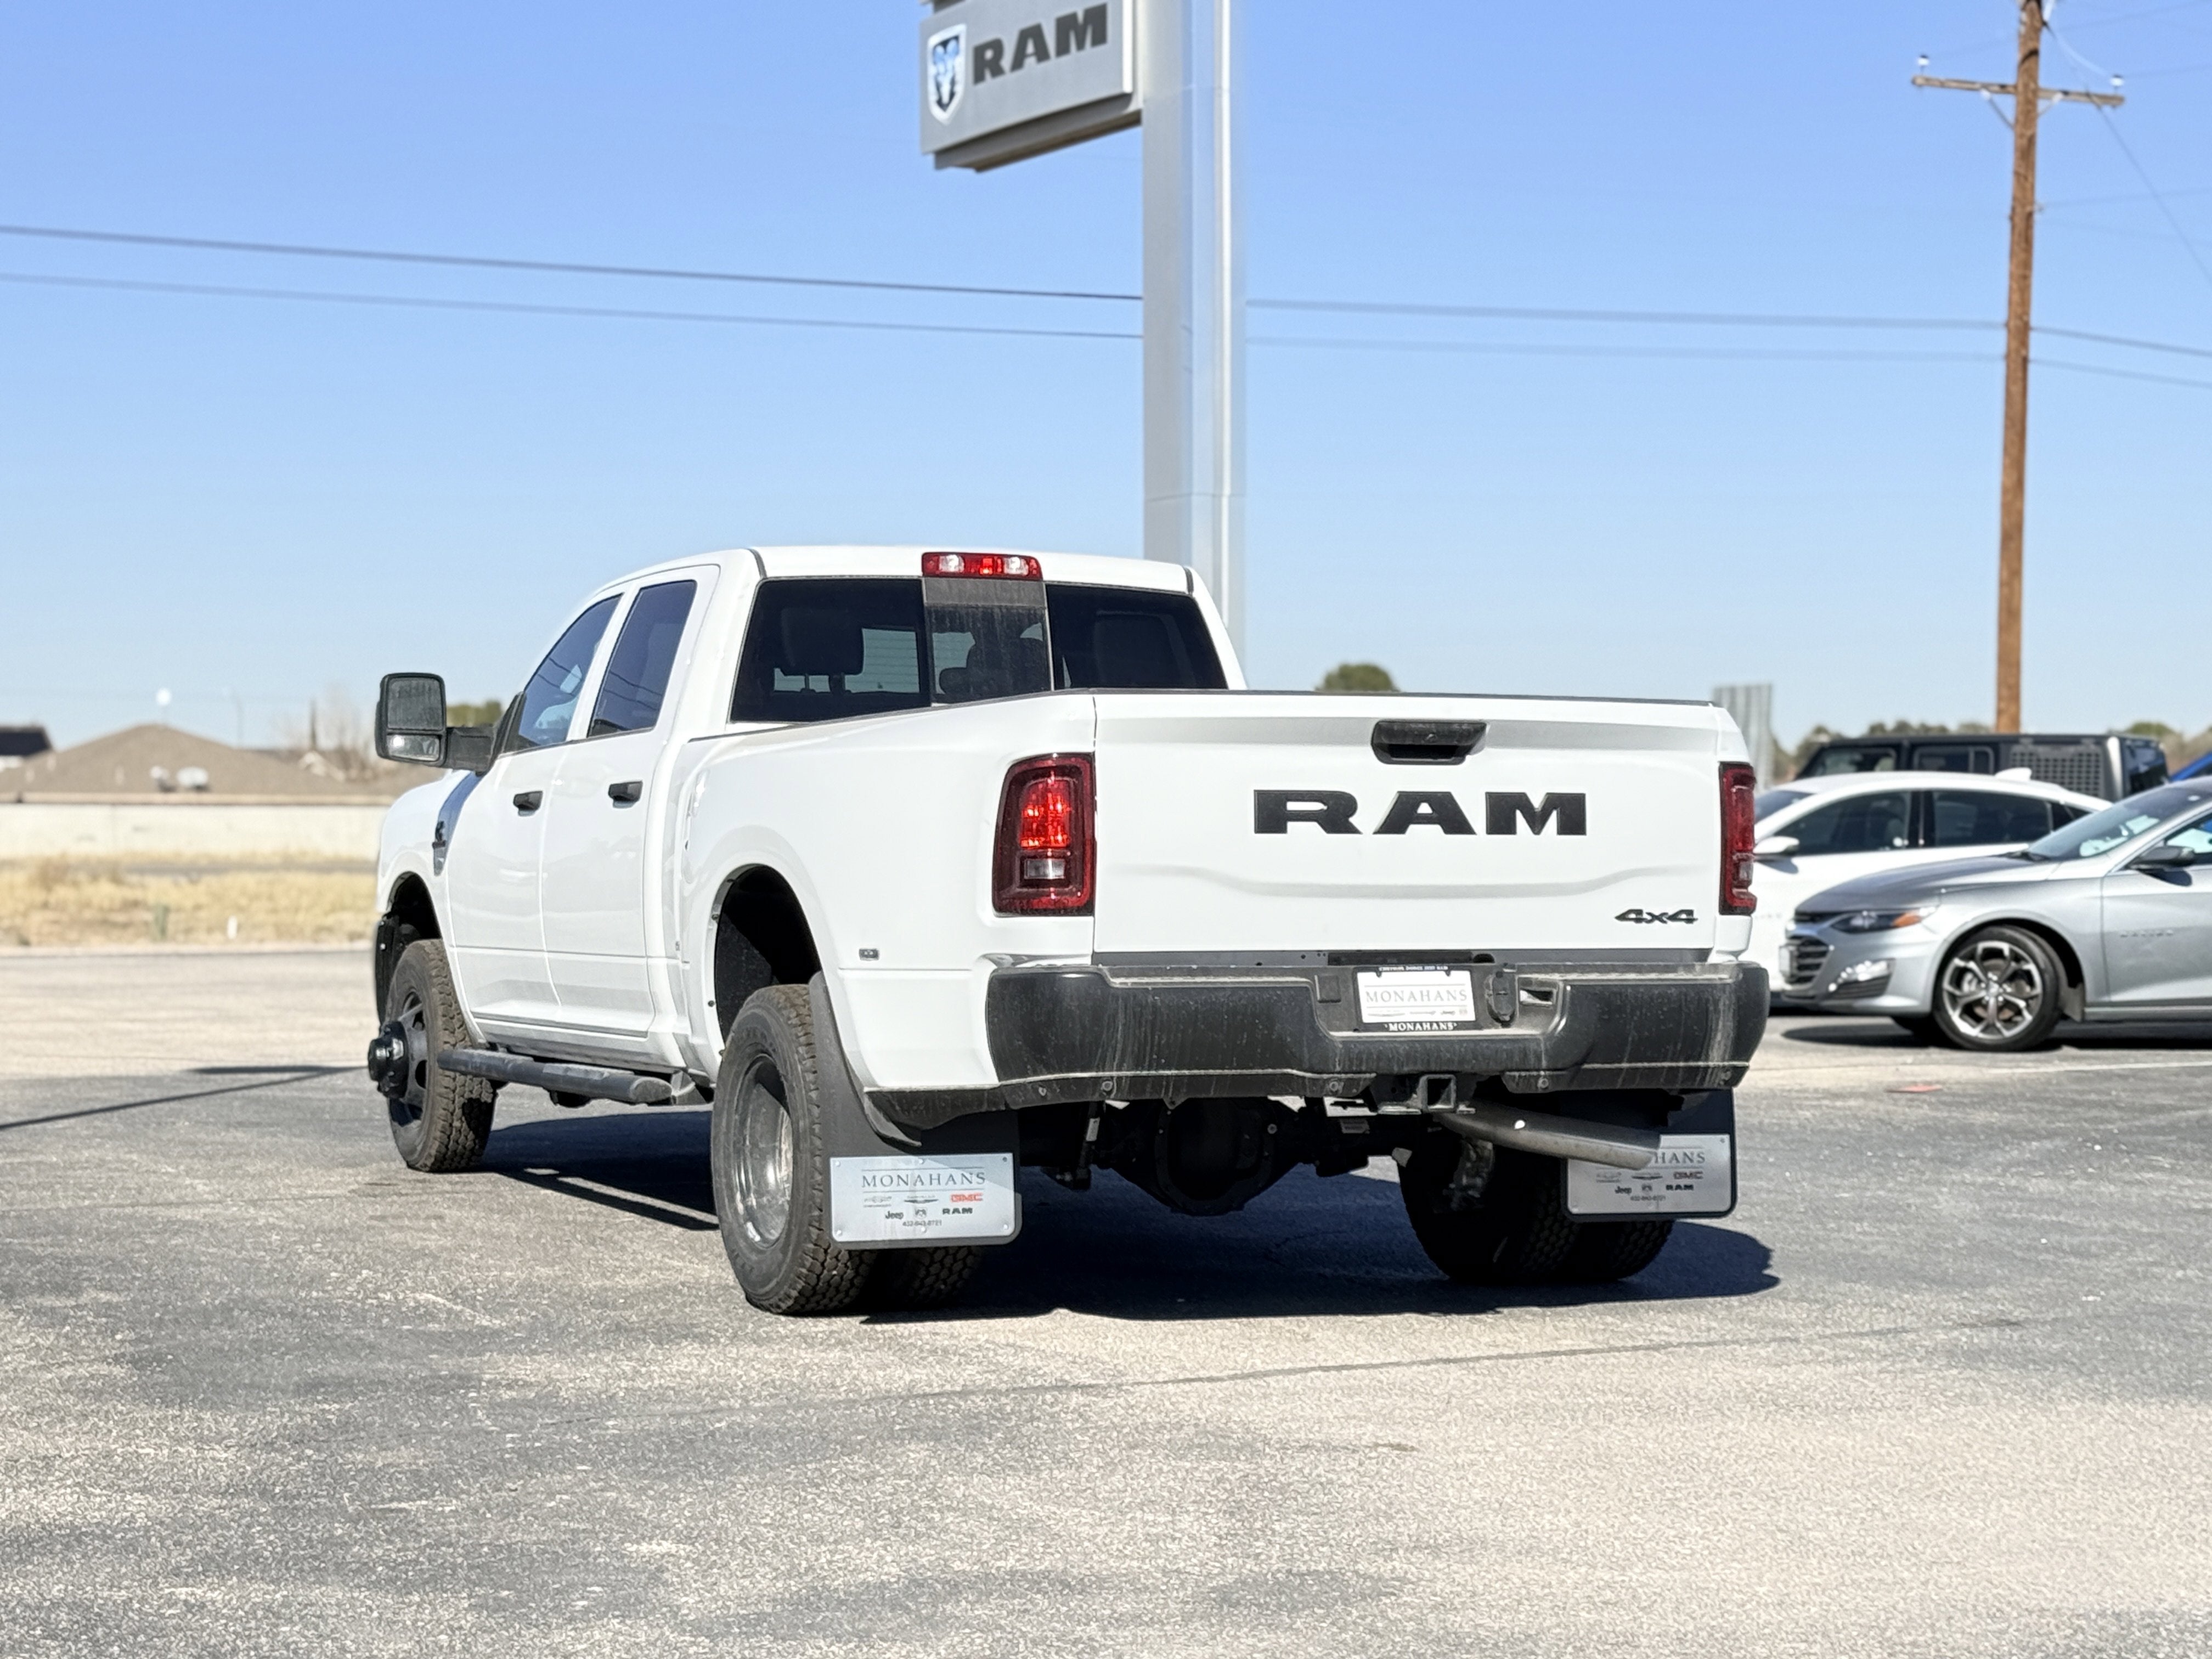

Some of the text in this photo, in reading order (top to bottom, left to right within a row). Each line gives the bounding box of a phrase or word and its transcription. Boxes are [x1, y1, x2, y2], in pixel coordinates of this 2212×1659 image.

[972, 3, 1107, 86] RAM
[1254, 789, 1587, 836] RAM
[1365, 989, 1467, 1002] MONAHANS
[1389, 1022, 1454, 1031] MONAHANS
[862, 1172, 985, 1188] MONAHANS
[1674, 1171, 1703, 1180] GMC
[950, 1193, 983, 1203] GMC
[885, 1210, 904, 1220] Jeep
